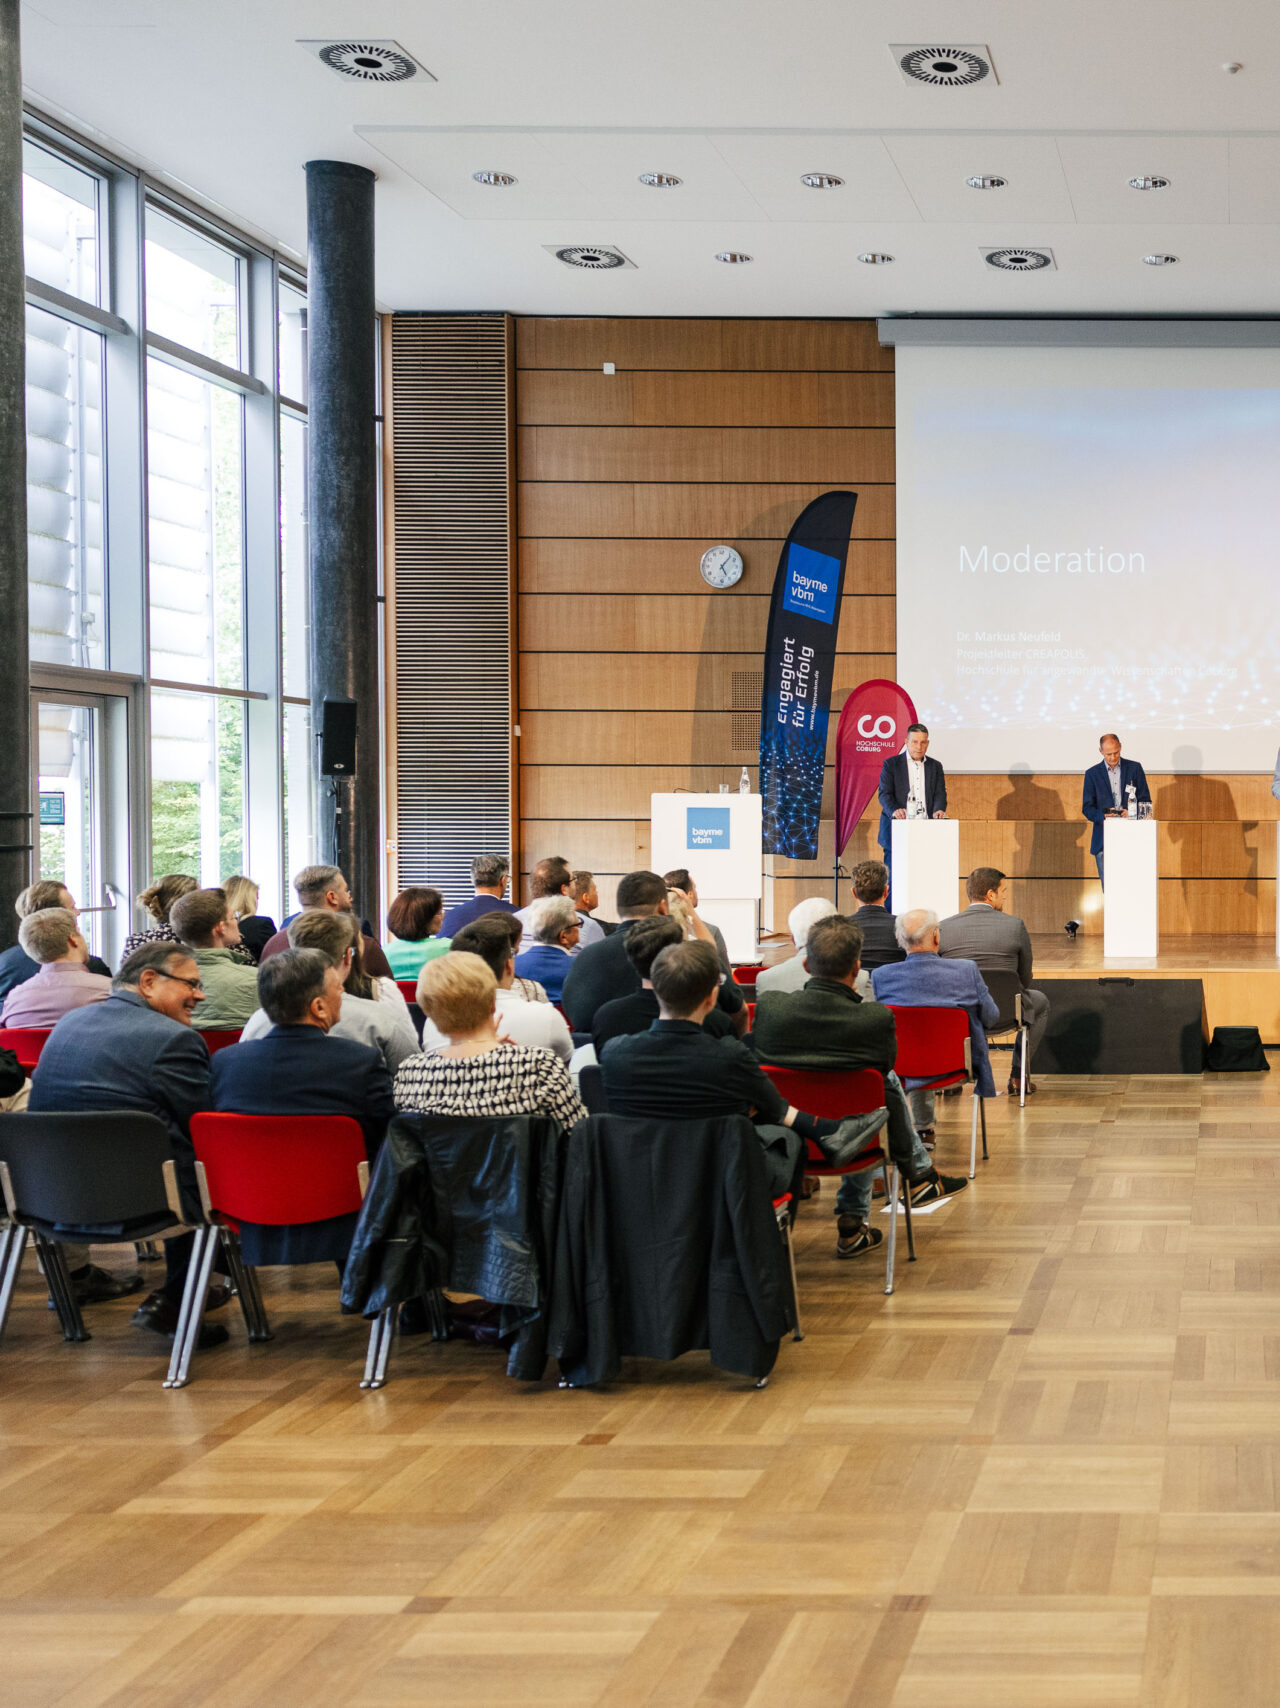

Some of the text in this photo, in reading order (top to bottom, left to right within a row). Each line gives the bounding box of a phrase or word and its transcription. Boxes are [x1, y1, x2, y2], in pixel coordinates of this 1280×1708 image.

[959, 544, 1146, 574] Moderation
[792, 570, 828, 593] bayme
[791, 586, 815, 602] vbm
[956, 631, 1062, 642] Dr. Markus Neufeld
[777, 636, 796, 724] Engagiert
[792, 645, 815, 728] für Erfolg
[856, 740, 896, 748] HOCHSCHULE
[856, 745, 882, 753] COBURG
[692, 827, 723, 837] bayme
[692, 836, 713, 844] vbm
